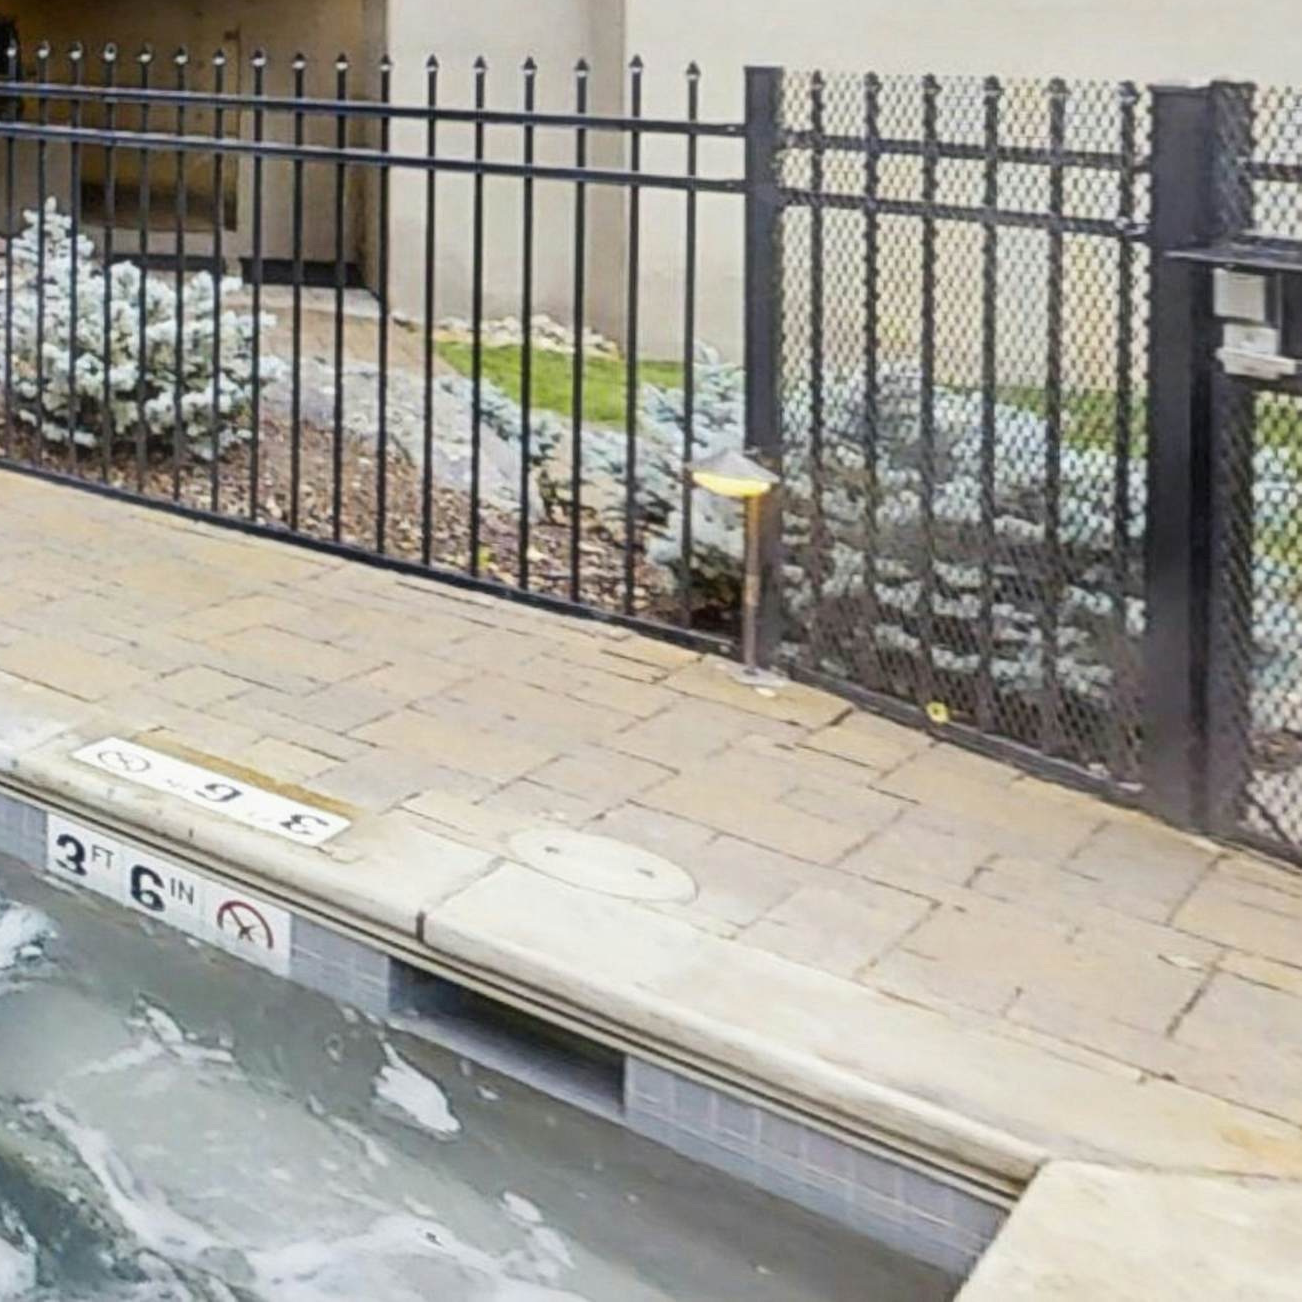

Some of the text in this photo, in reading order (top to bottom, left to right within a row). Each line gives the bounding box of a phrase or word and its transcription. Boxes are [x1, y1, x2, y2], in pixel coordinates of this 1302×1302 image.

[55, 833, 195, 912] 3 FT 6 IN
